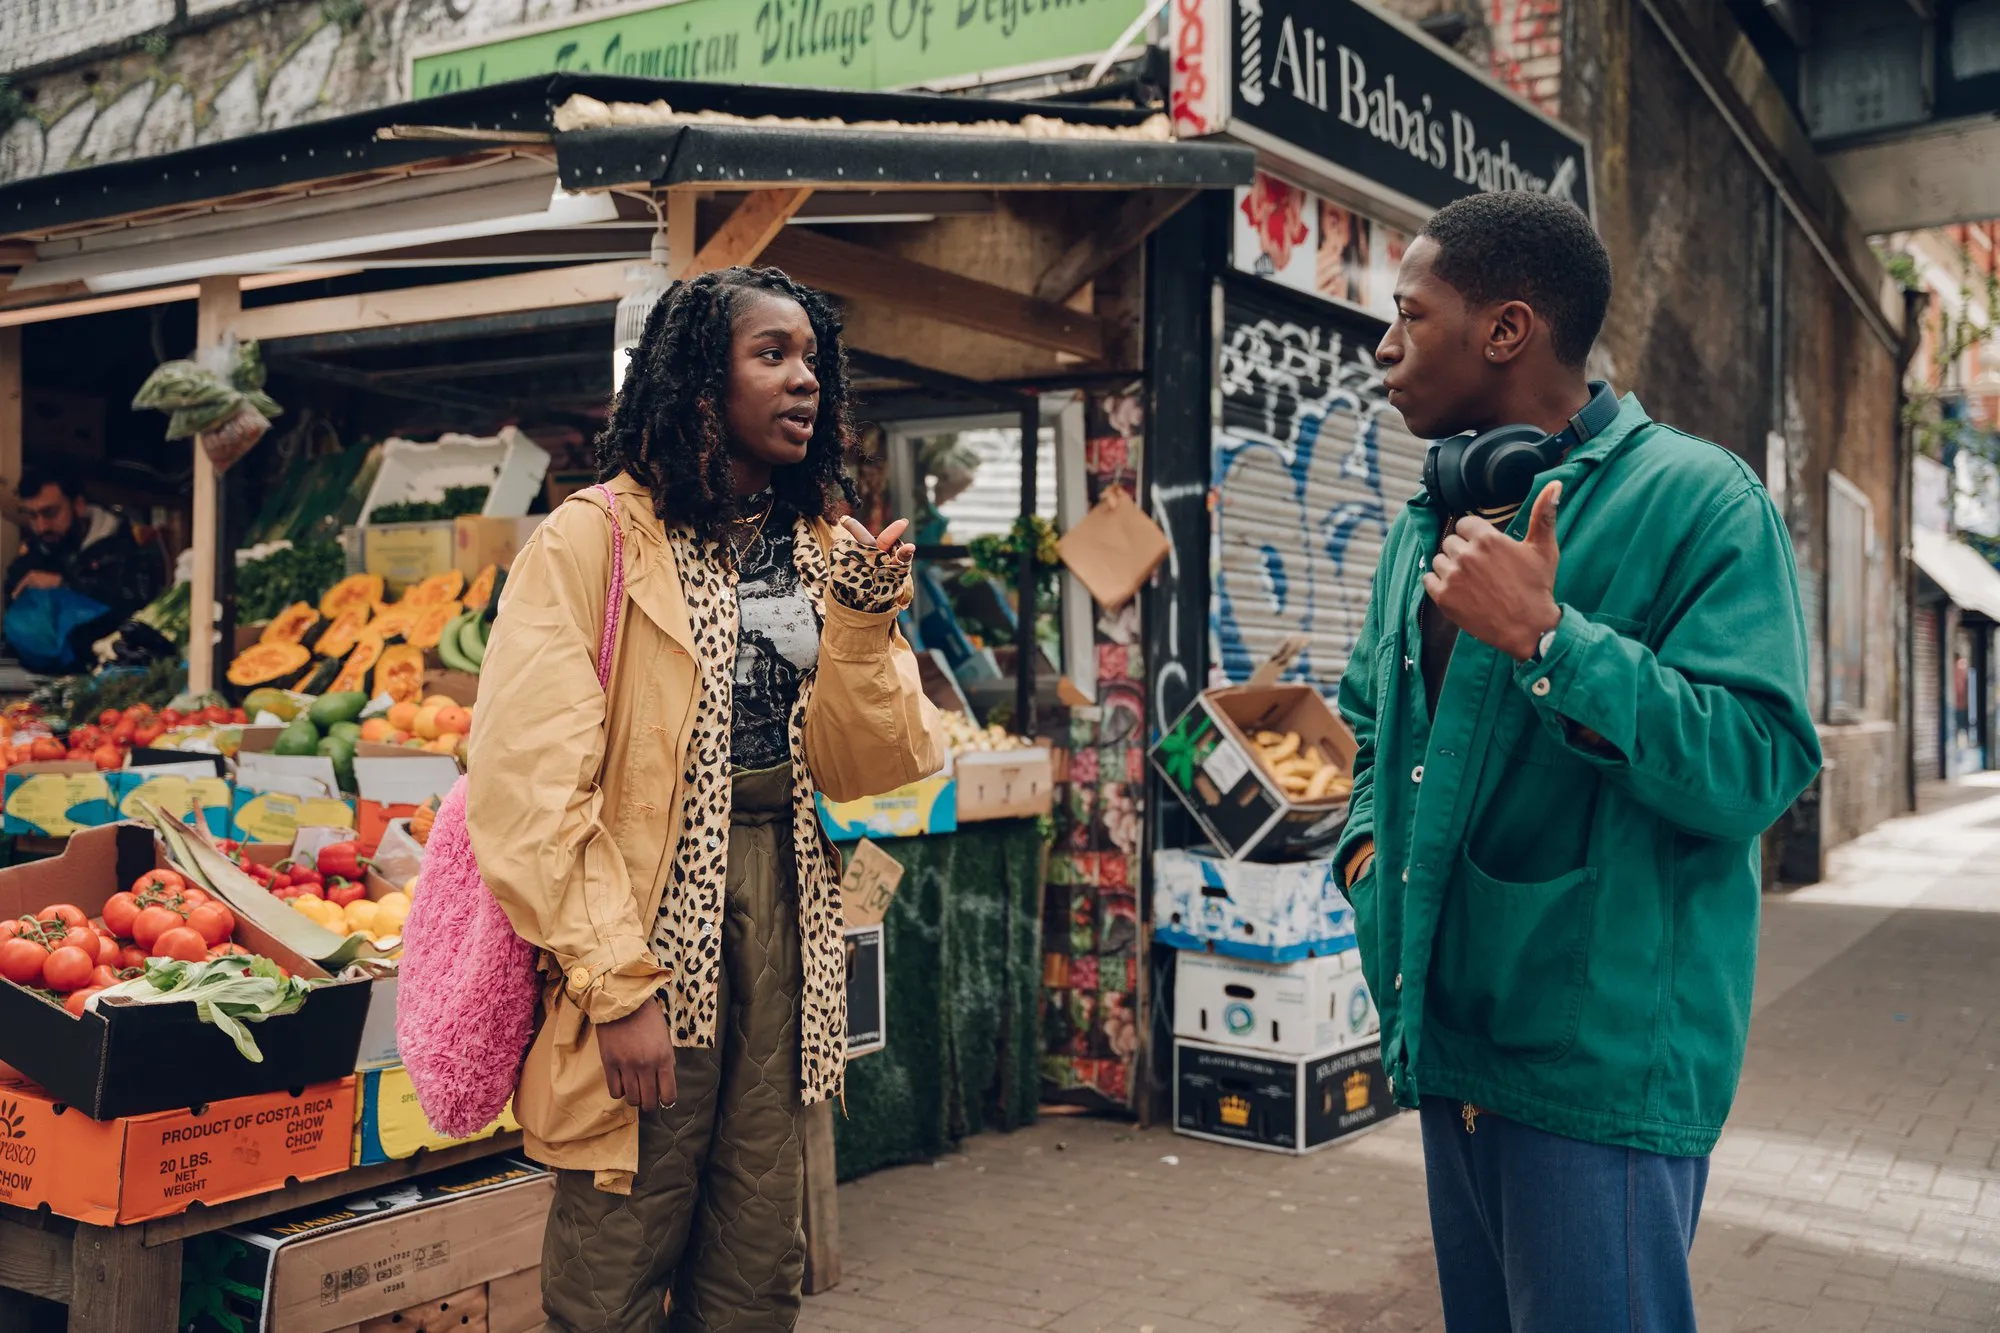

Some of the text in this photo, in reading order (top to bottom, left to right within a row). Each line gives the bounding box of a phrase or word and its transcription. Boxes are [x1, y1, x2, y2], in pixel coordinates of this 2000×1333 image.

[756, 0, 875, 67] Village
[1269, 15, 1328, 111] Ali
[1338, 45, 1448, 170] Baba's
[162, 1098, 333, 1145] PRODUCT OF COSTA RICA
[287, 1115, 325, 1134] CHOW
[285, 1129, 324, 1149] CHOW
[160, 1152, 212, 1175] 20 LBS.
[175, 1169, 197, 1183] NET
[163, 1179, 207, 1198] WEIGHT
